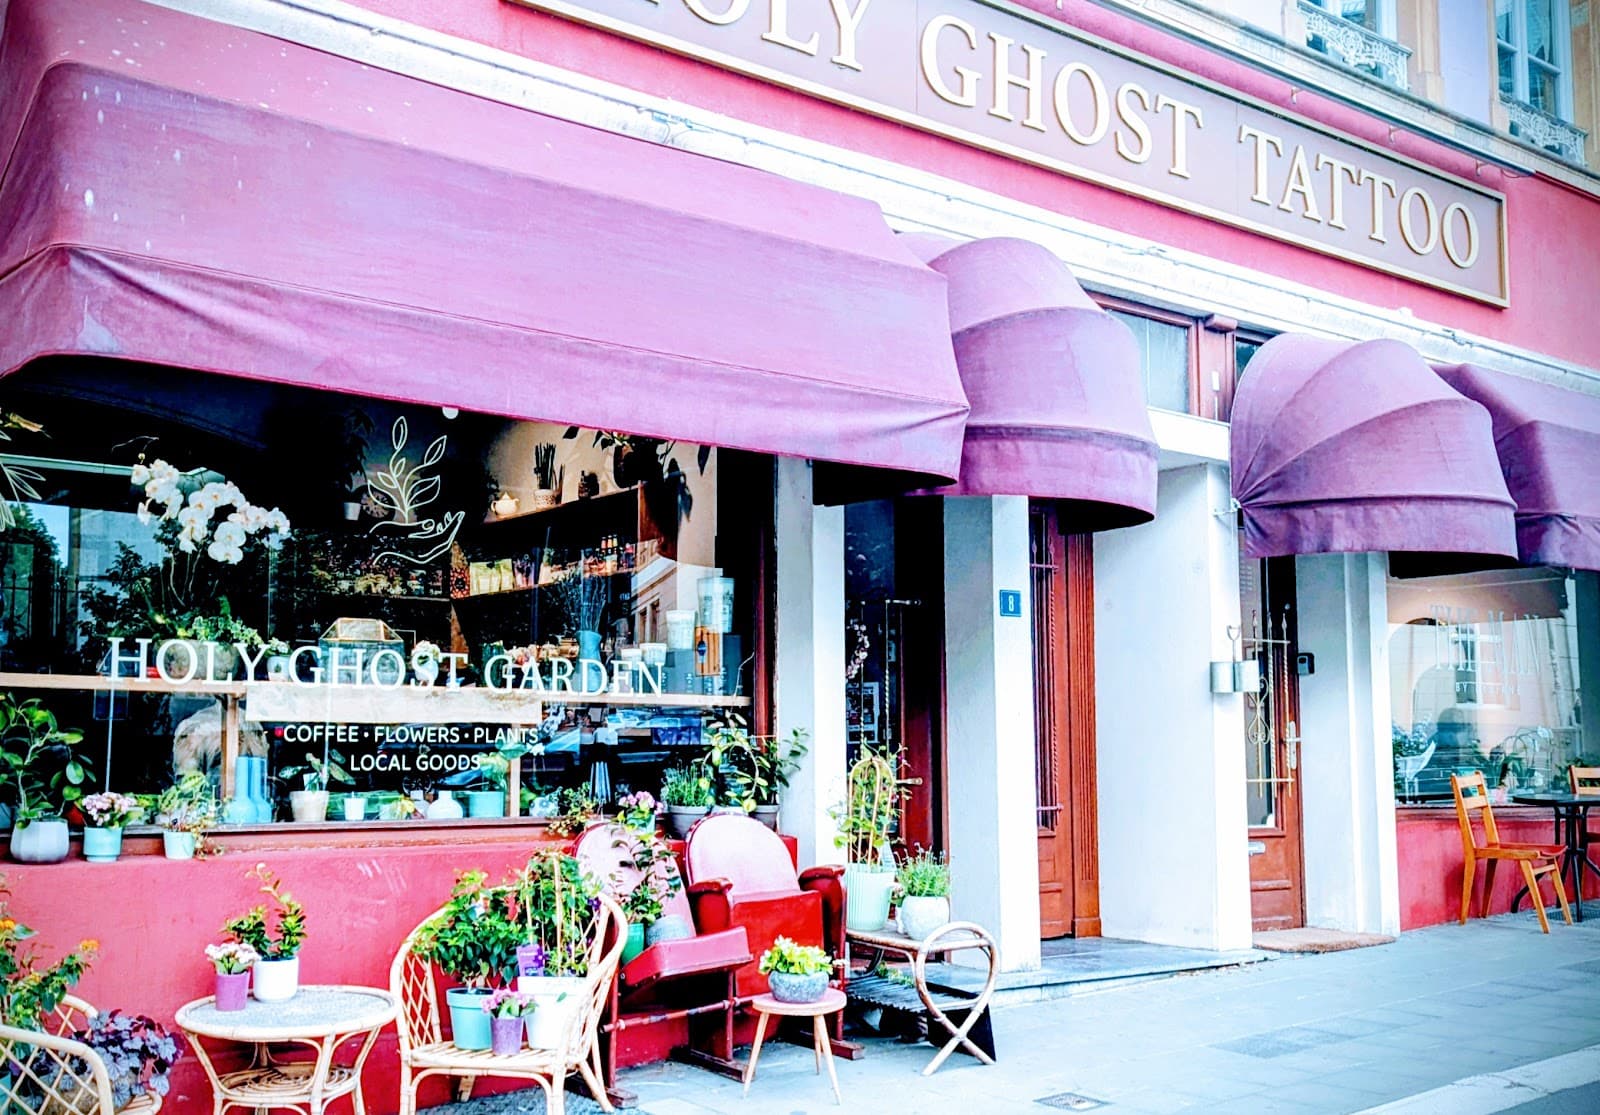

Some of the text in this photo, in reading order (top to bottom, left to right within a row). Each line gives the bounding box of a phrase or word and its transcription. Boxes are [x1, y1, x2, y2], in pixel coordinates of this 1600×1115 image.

[920, 14, 1203, 179] GHOST
[1238, 124, 1480, 270] TATTOO
[1008, 594, 1015, 612] 8
[107, 637, 665, 698] HOLY GHOST GARDEN
[283, 724, 538, 744] COFFEE FLOWERS PLANTS
[350, 754, 481, 772] LOCAL GOODS
